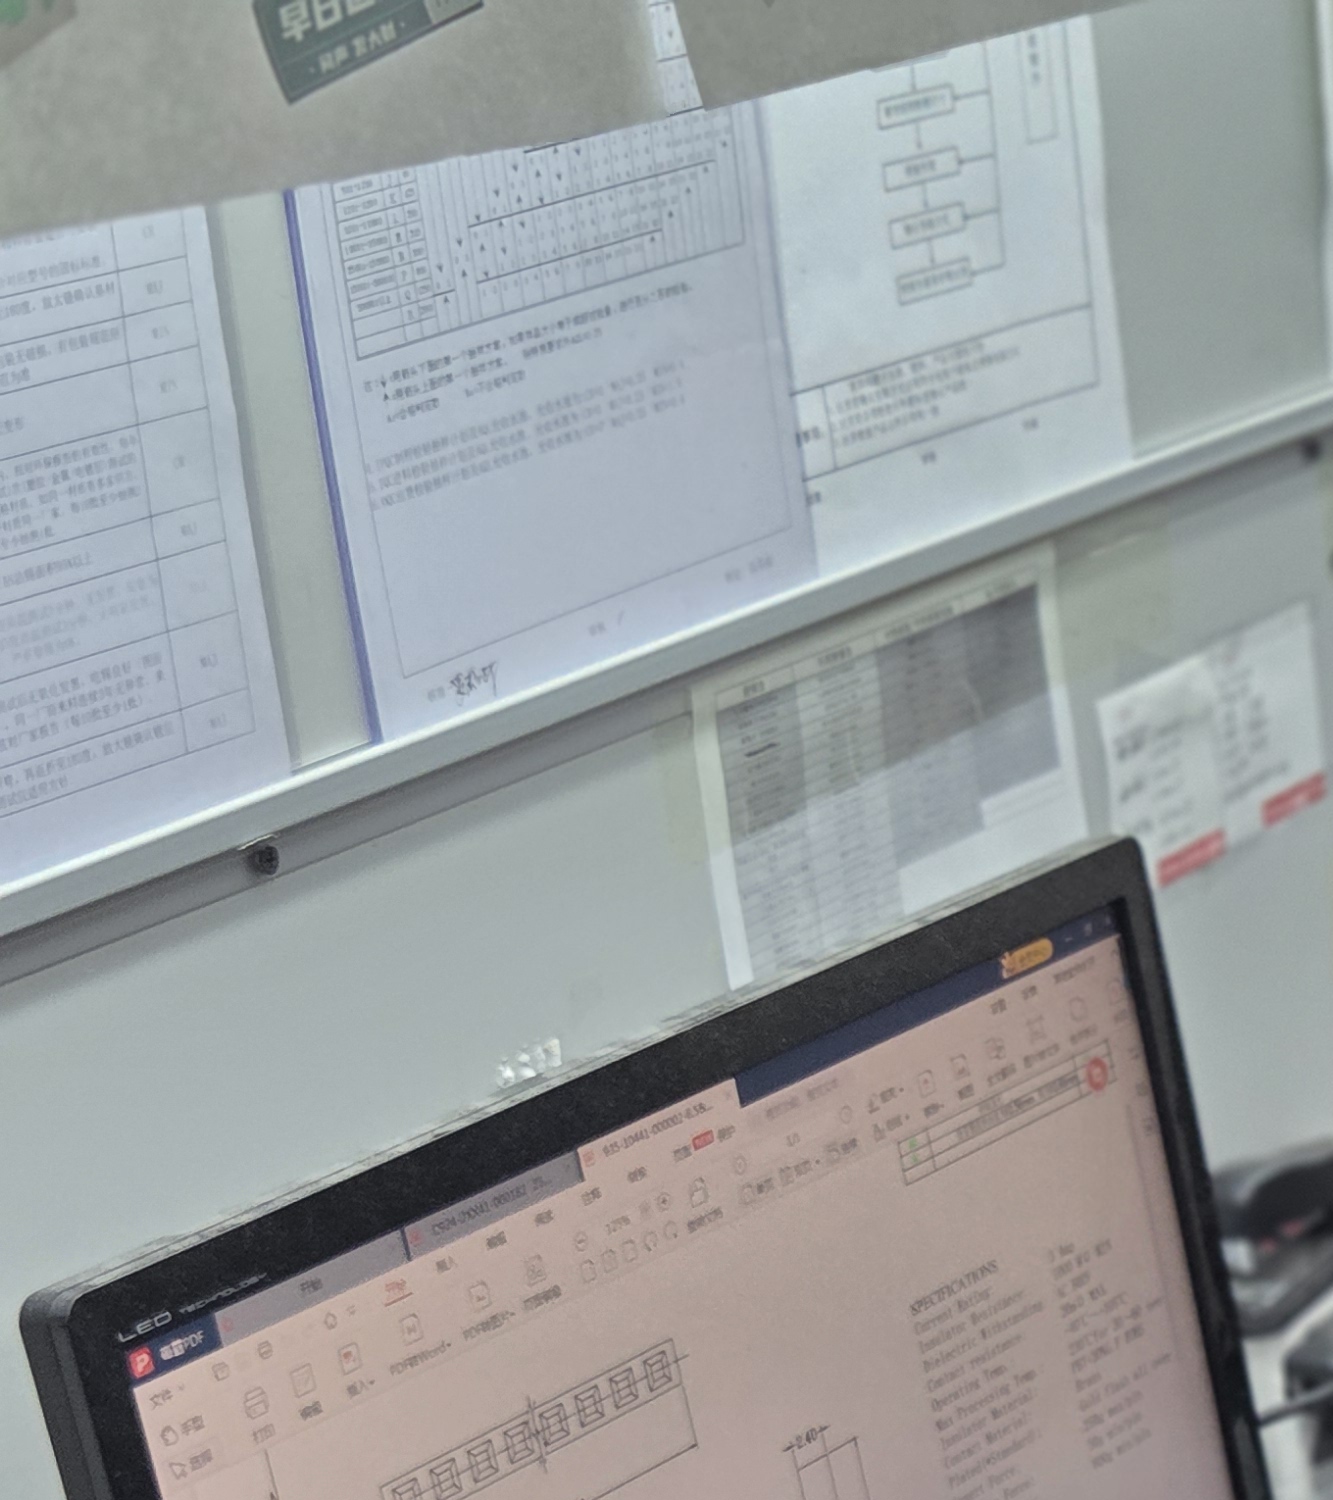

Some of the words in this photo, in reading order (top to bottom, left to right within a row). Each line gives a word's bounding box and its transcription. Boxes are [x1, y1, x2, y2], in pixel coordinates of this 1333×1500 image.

[909, 1258, 998, 1317] SPECIFICATIONS
[117, 1311, 173, 1342] LED
[796, 1428, 817, 1449] 2.40
